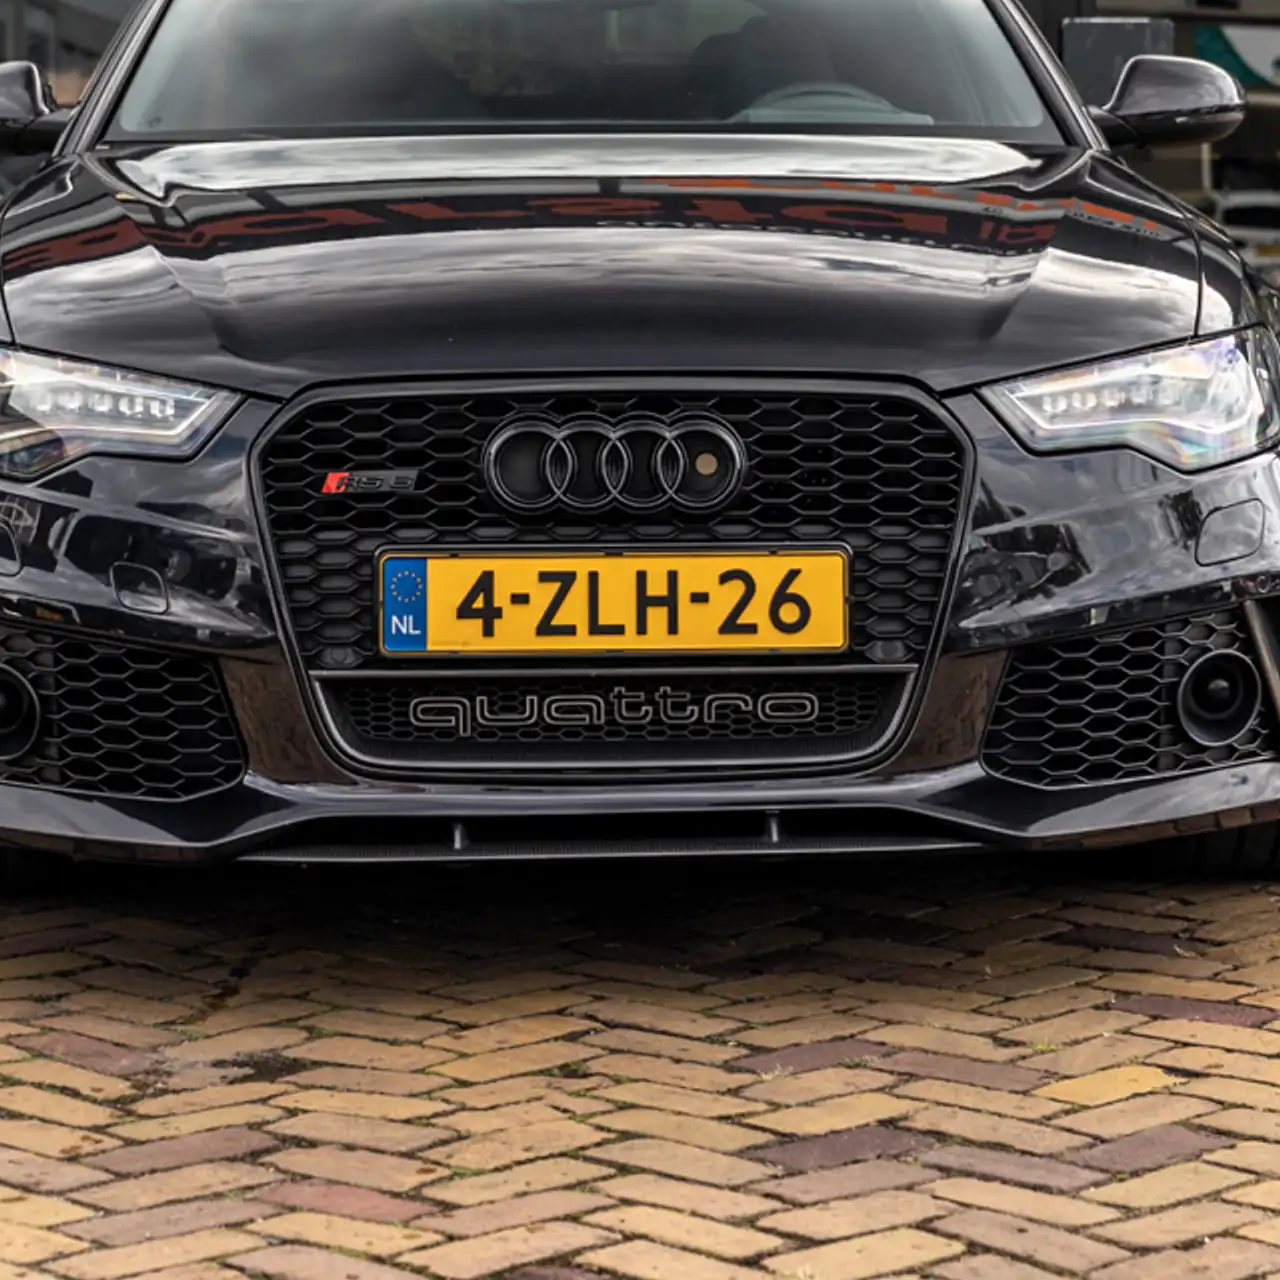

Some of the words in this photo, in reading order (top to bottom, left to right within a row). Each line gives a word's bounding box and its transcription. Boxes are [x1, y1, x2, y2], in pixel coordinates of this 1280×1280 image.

[391, 616, 421, 635] NL
[456, 568, 812, 637] 4-ZLH-26
[410, 686, 819, 736] quattro
